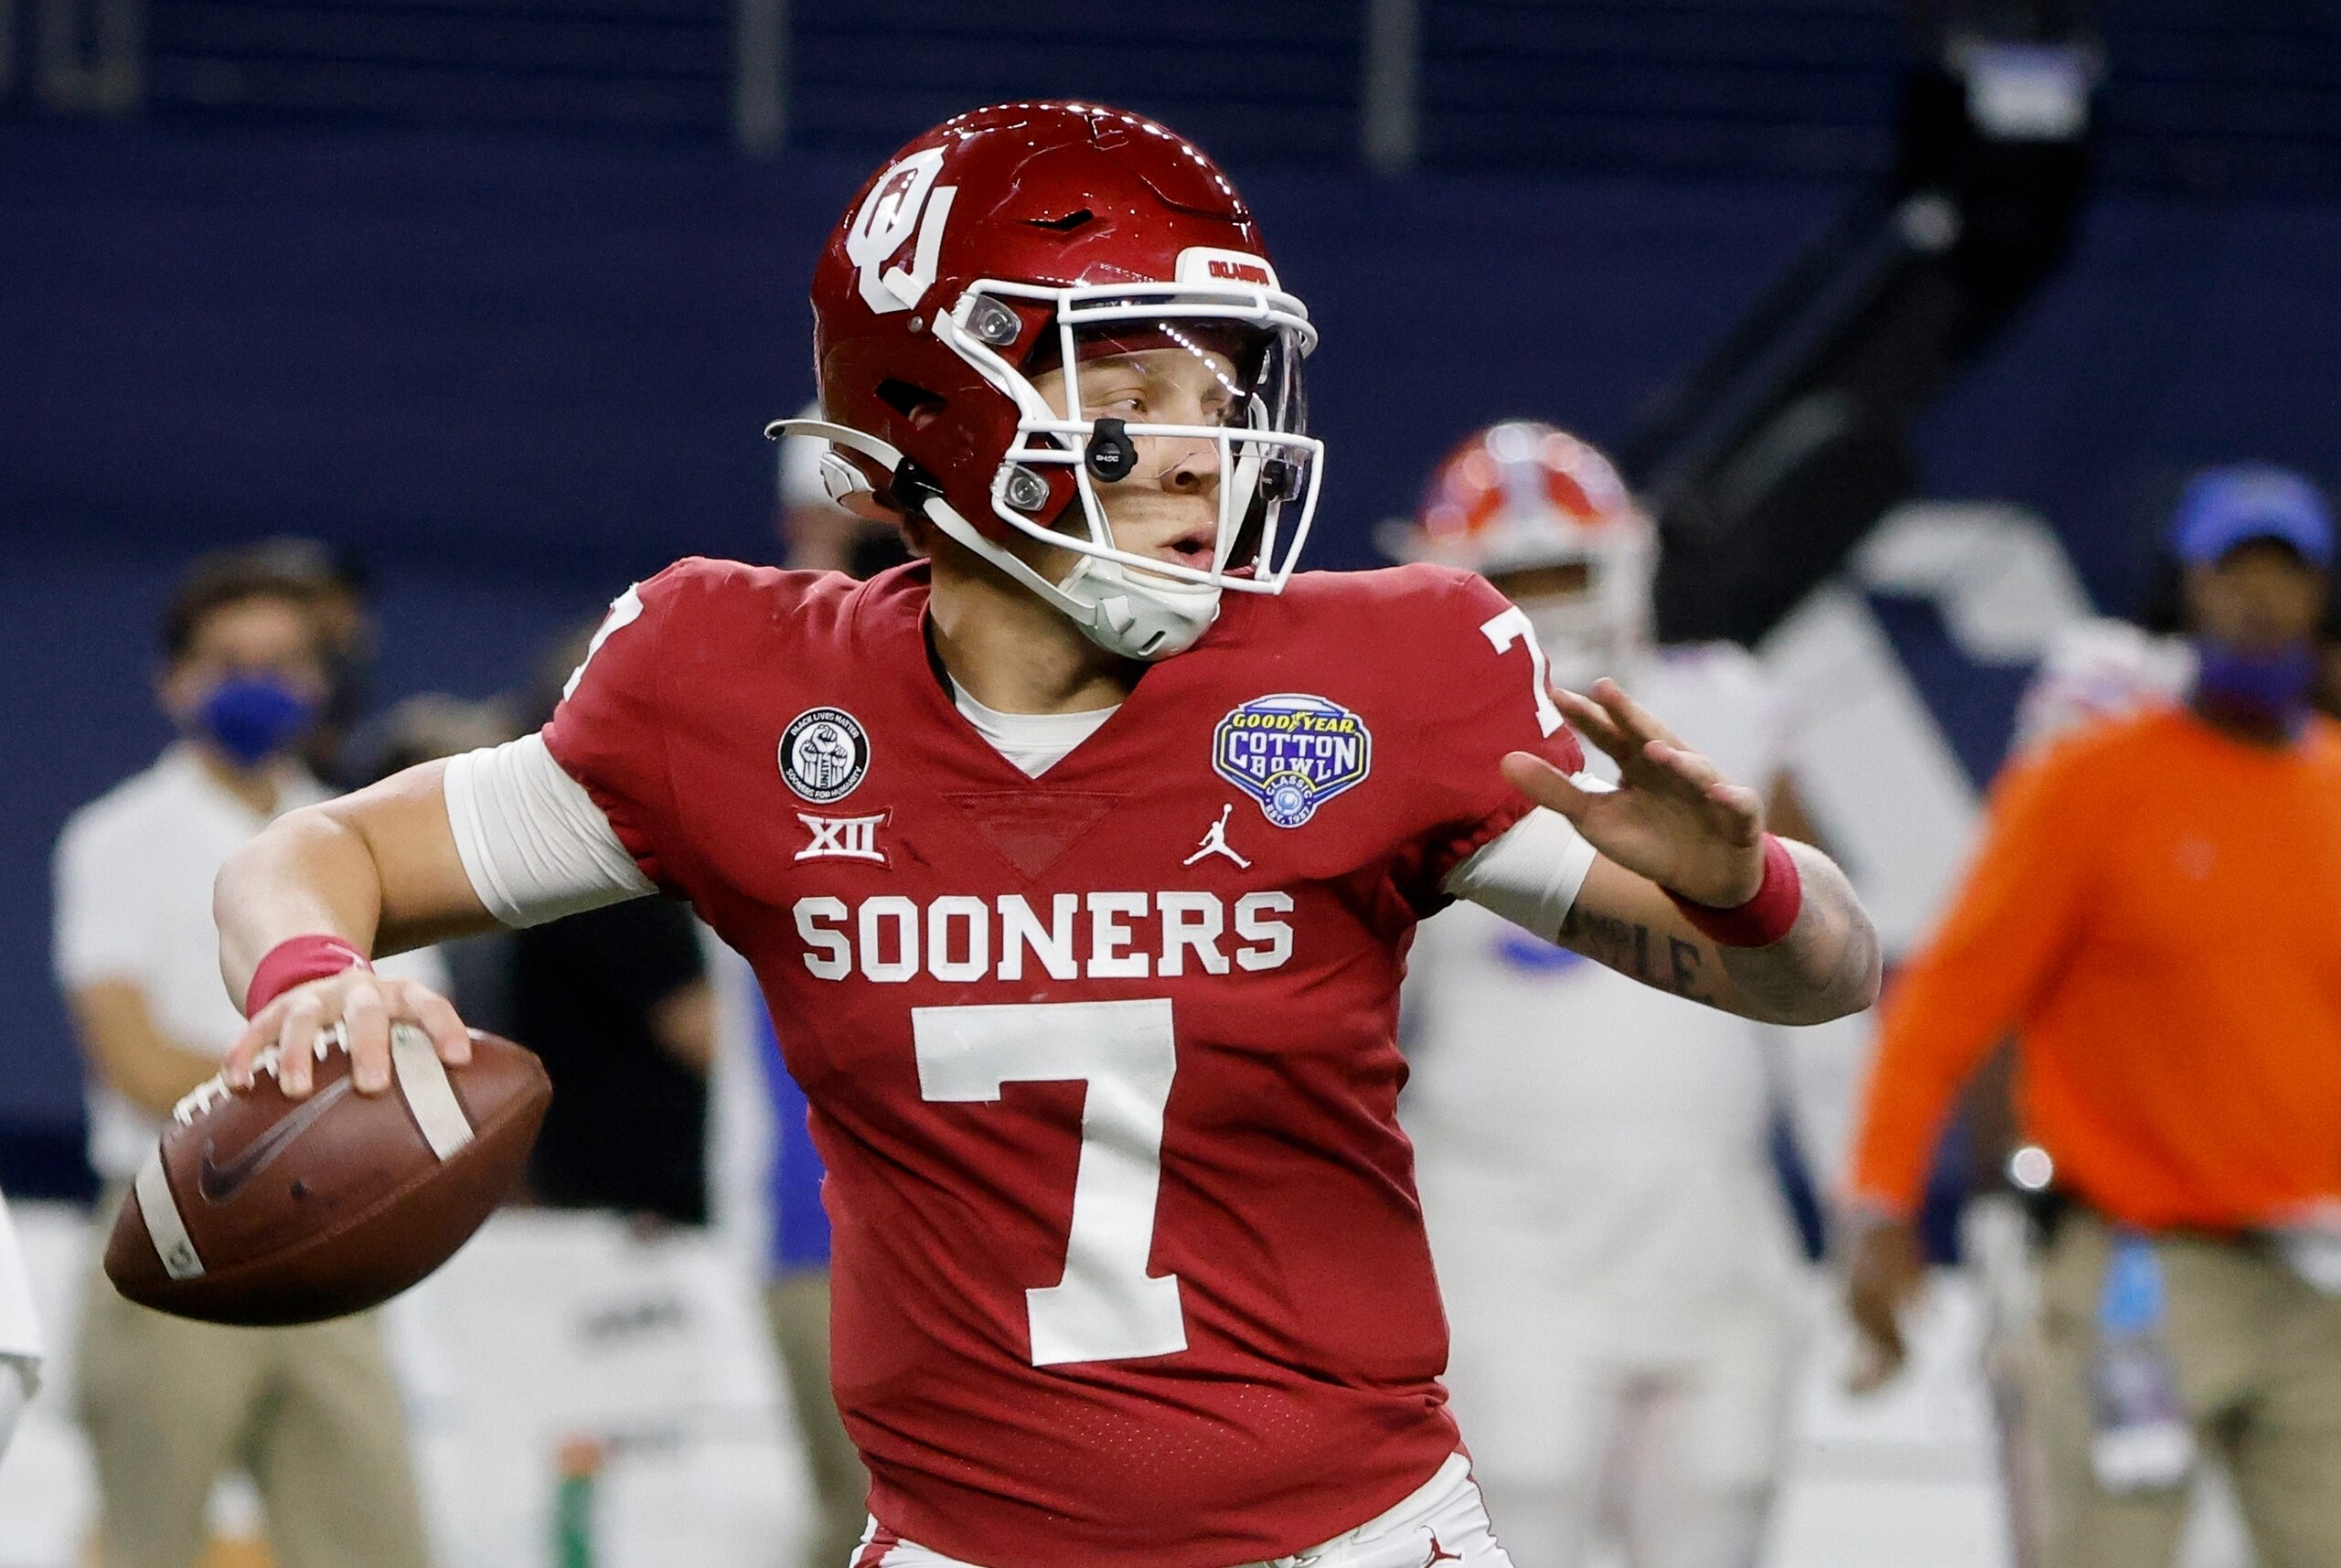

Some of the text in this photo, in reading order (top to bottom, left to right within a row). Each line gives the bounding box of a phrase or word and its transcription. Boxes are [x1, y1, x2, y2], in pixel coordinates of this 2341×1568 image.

[1480, 604, 1565, 739] 7
[790, 712, 860, 739] BLACK LIVES MATTER
[1228, 731, 1356, 775] COTTON
[1250, 754, 1332, 781] BOWL
[786, 765, 862, 798] SOONERS FOR HUMANITY
[1266, 775, 1313, 799] CLASSIC
[794, 812, 886, 861] XII
[792, 891, 1295, 983] SOONERS
[911, 997, 1189, 1367] 7
